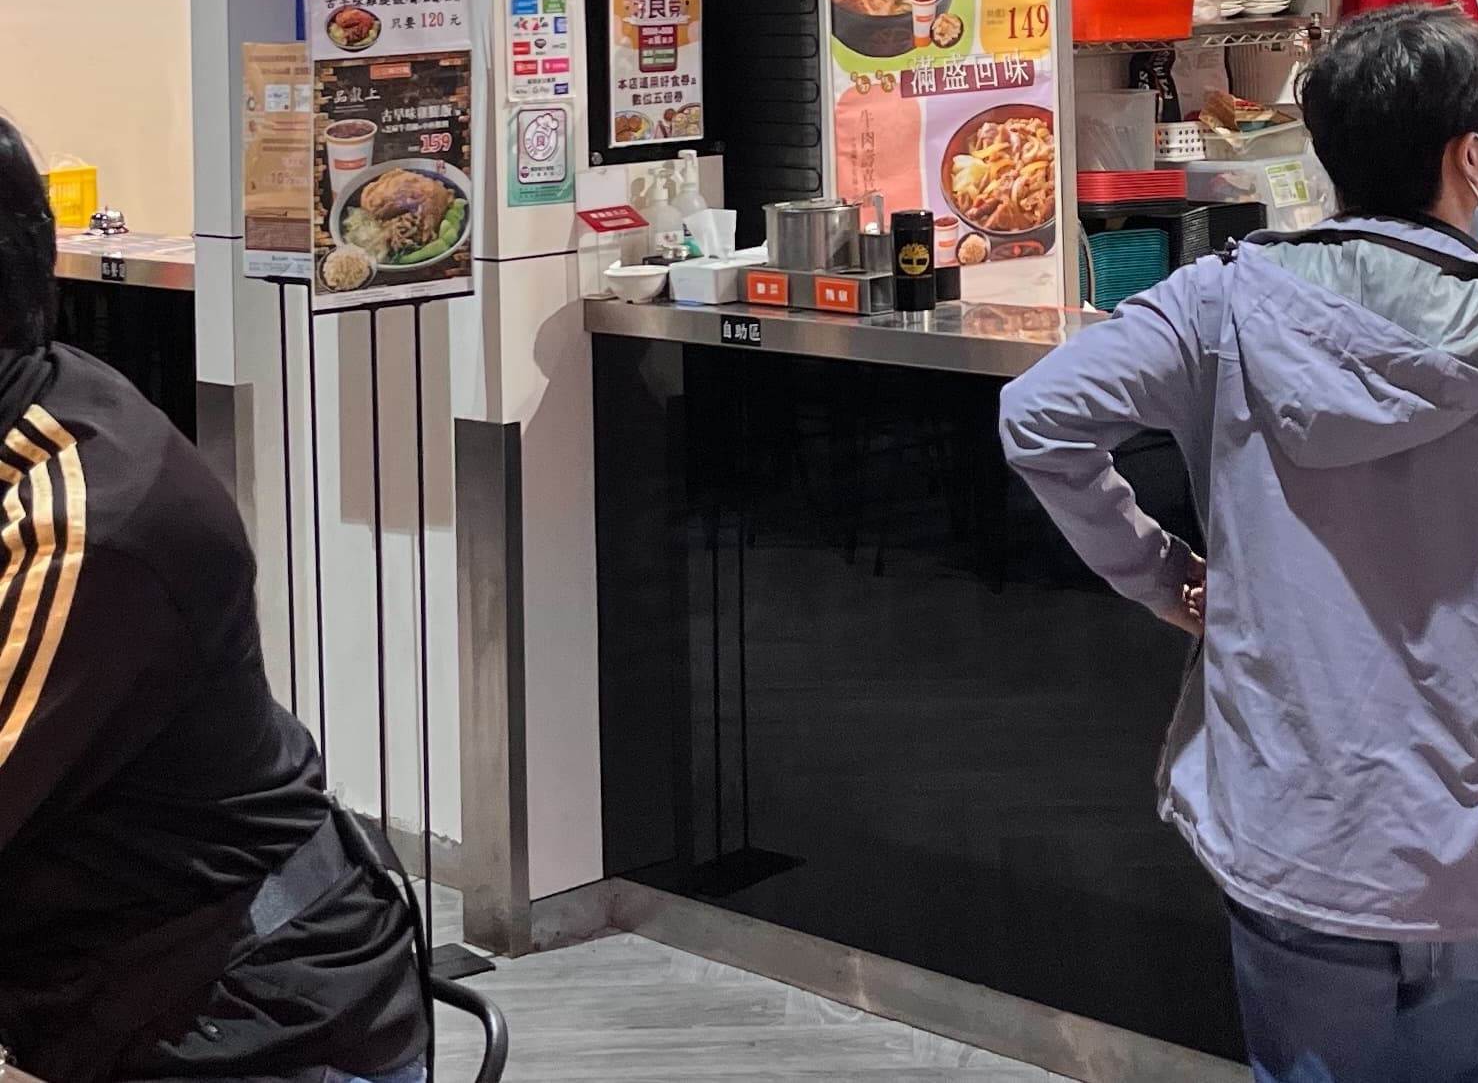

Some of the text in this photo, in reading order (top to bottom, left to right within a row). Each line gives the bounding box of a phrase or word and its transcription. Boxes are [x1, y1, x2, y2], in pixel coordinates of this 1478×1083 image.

[391, 12, 462, 30] 只要 120 元
[1008, 4, 1050, 39] 149
[910, 49, 1030, 94] 滿盛回味
[419, 132, 453, 154] 159
[723, 320, 761, 342] 自助區
